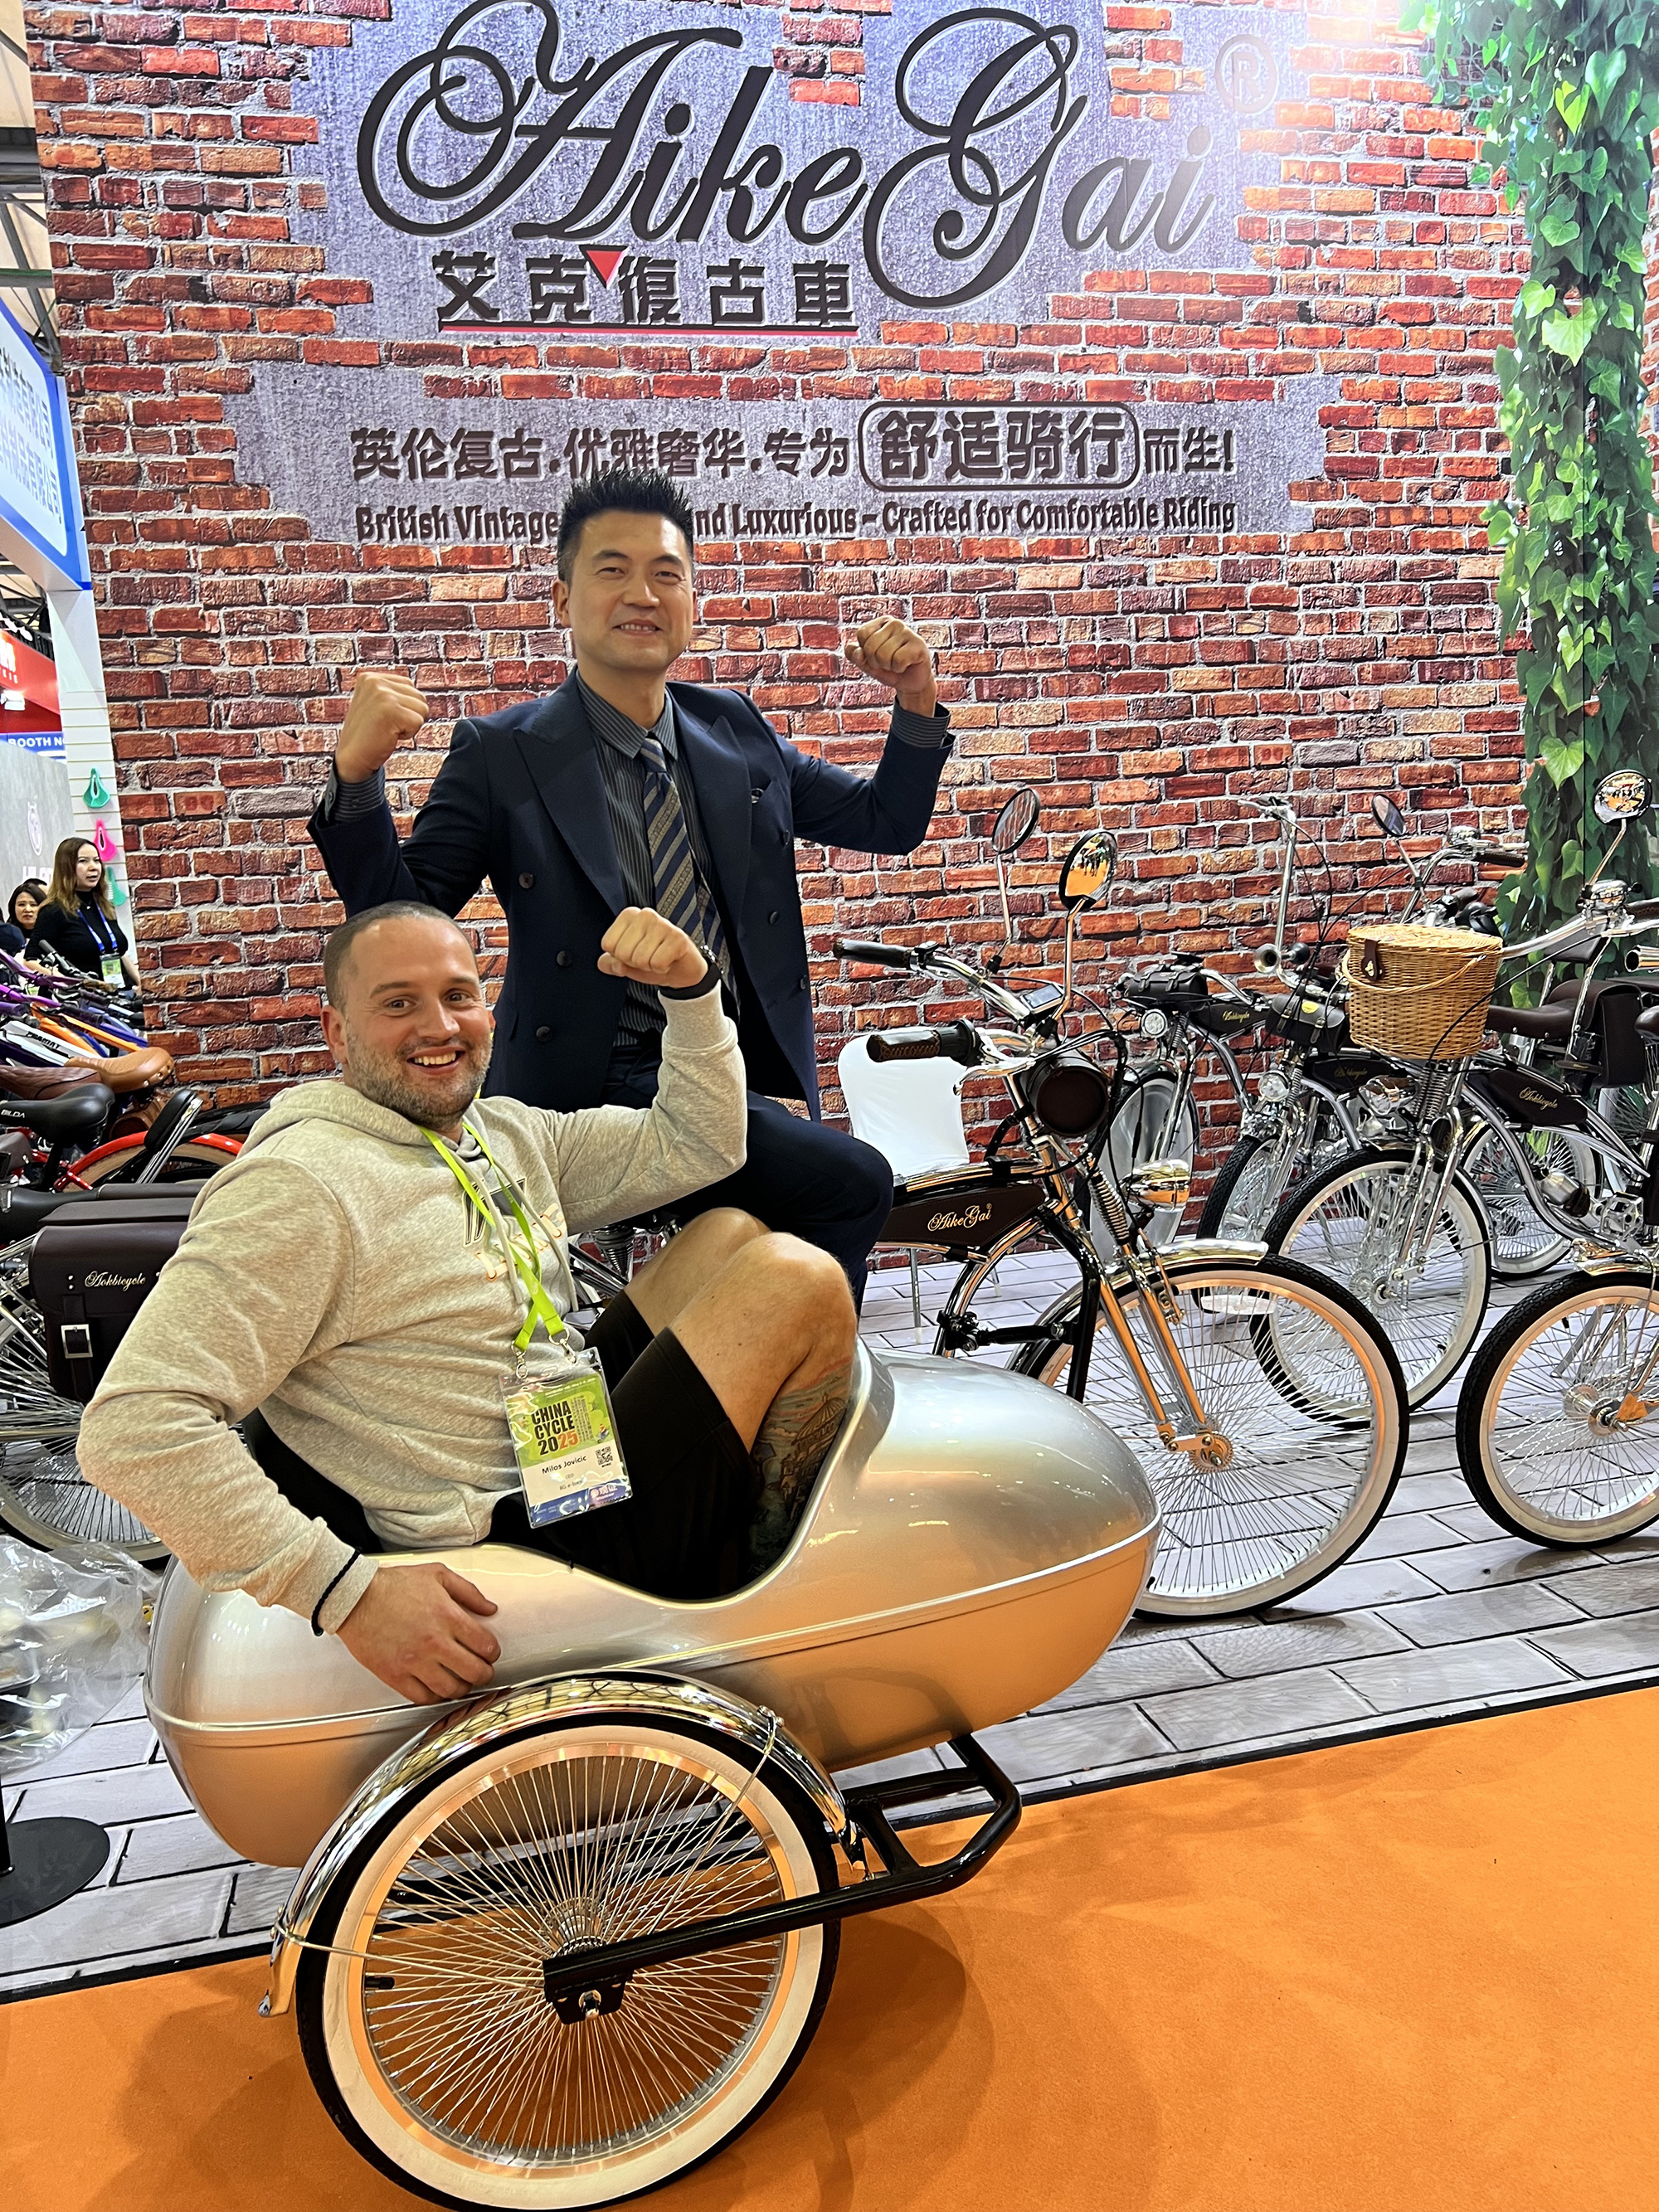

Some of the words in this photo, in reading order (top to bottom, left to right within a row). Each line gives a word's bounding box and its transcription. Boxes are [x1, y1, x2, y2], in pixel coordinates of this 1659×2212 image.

[432, 250, 855, 324] 艾克復古車
[356, 506, 448, 542] British
[454, 505, 558, 545] Vintage
[696, 502, 724, 537] nd
[732, 501, 857, 537] Luxurious
[883, 501, 971, 535] Crafted
[976, 500, 1012, 532] for
[1017, 499, 1158, 533] Comfortable
[1164, 498, 1235, 533] Riding
[85, 1271, 146, 1291] Aokbicycle
[531, 1400, 572, 1425] CHINA
[534, 1415, 575, 1440] CYCLE
[538, 1430, 579, 1456] 2025
[542, 1464, 562, 1475] Milos
[563, 1455, 587, 1468] Jovicic
